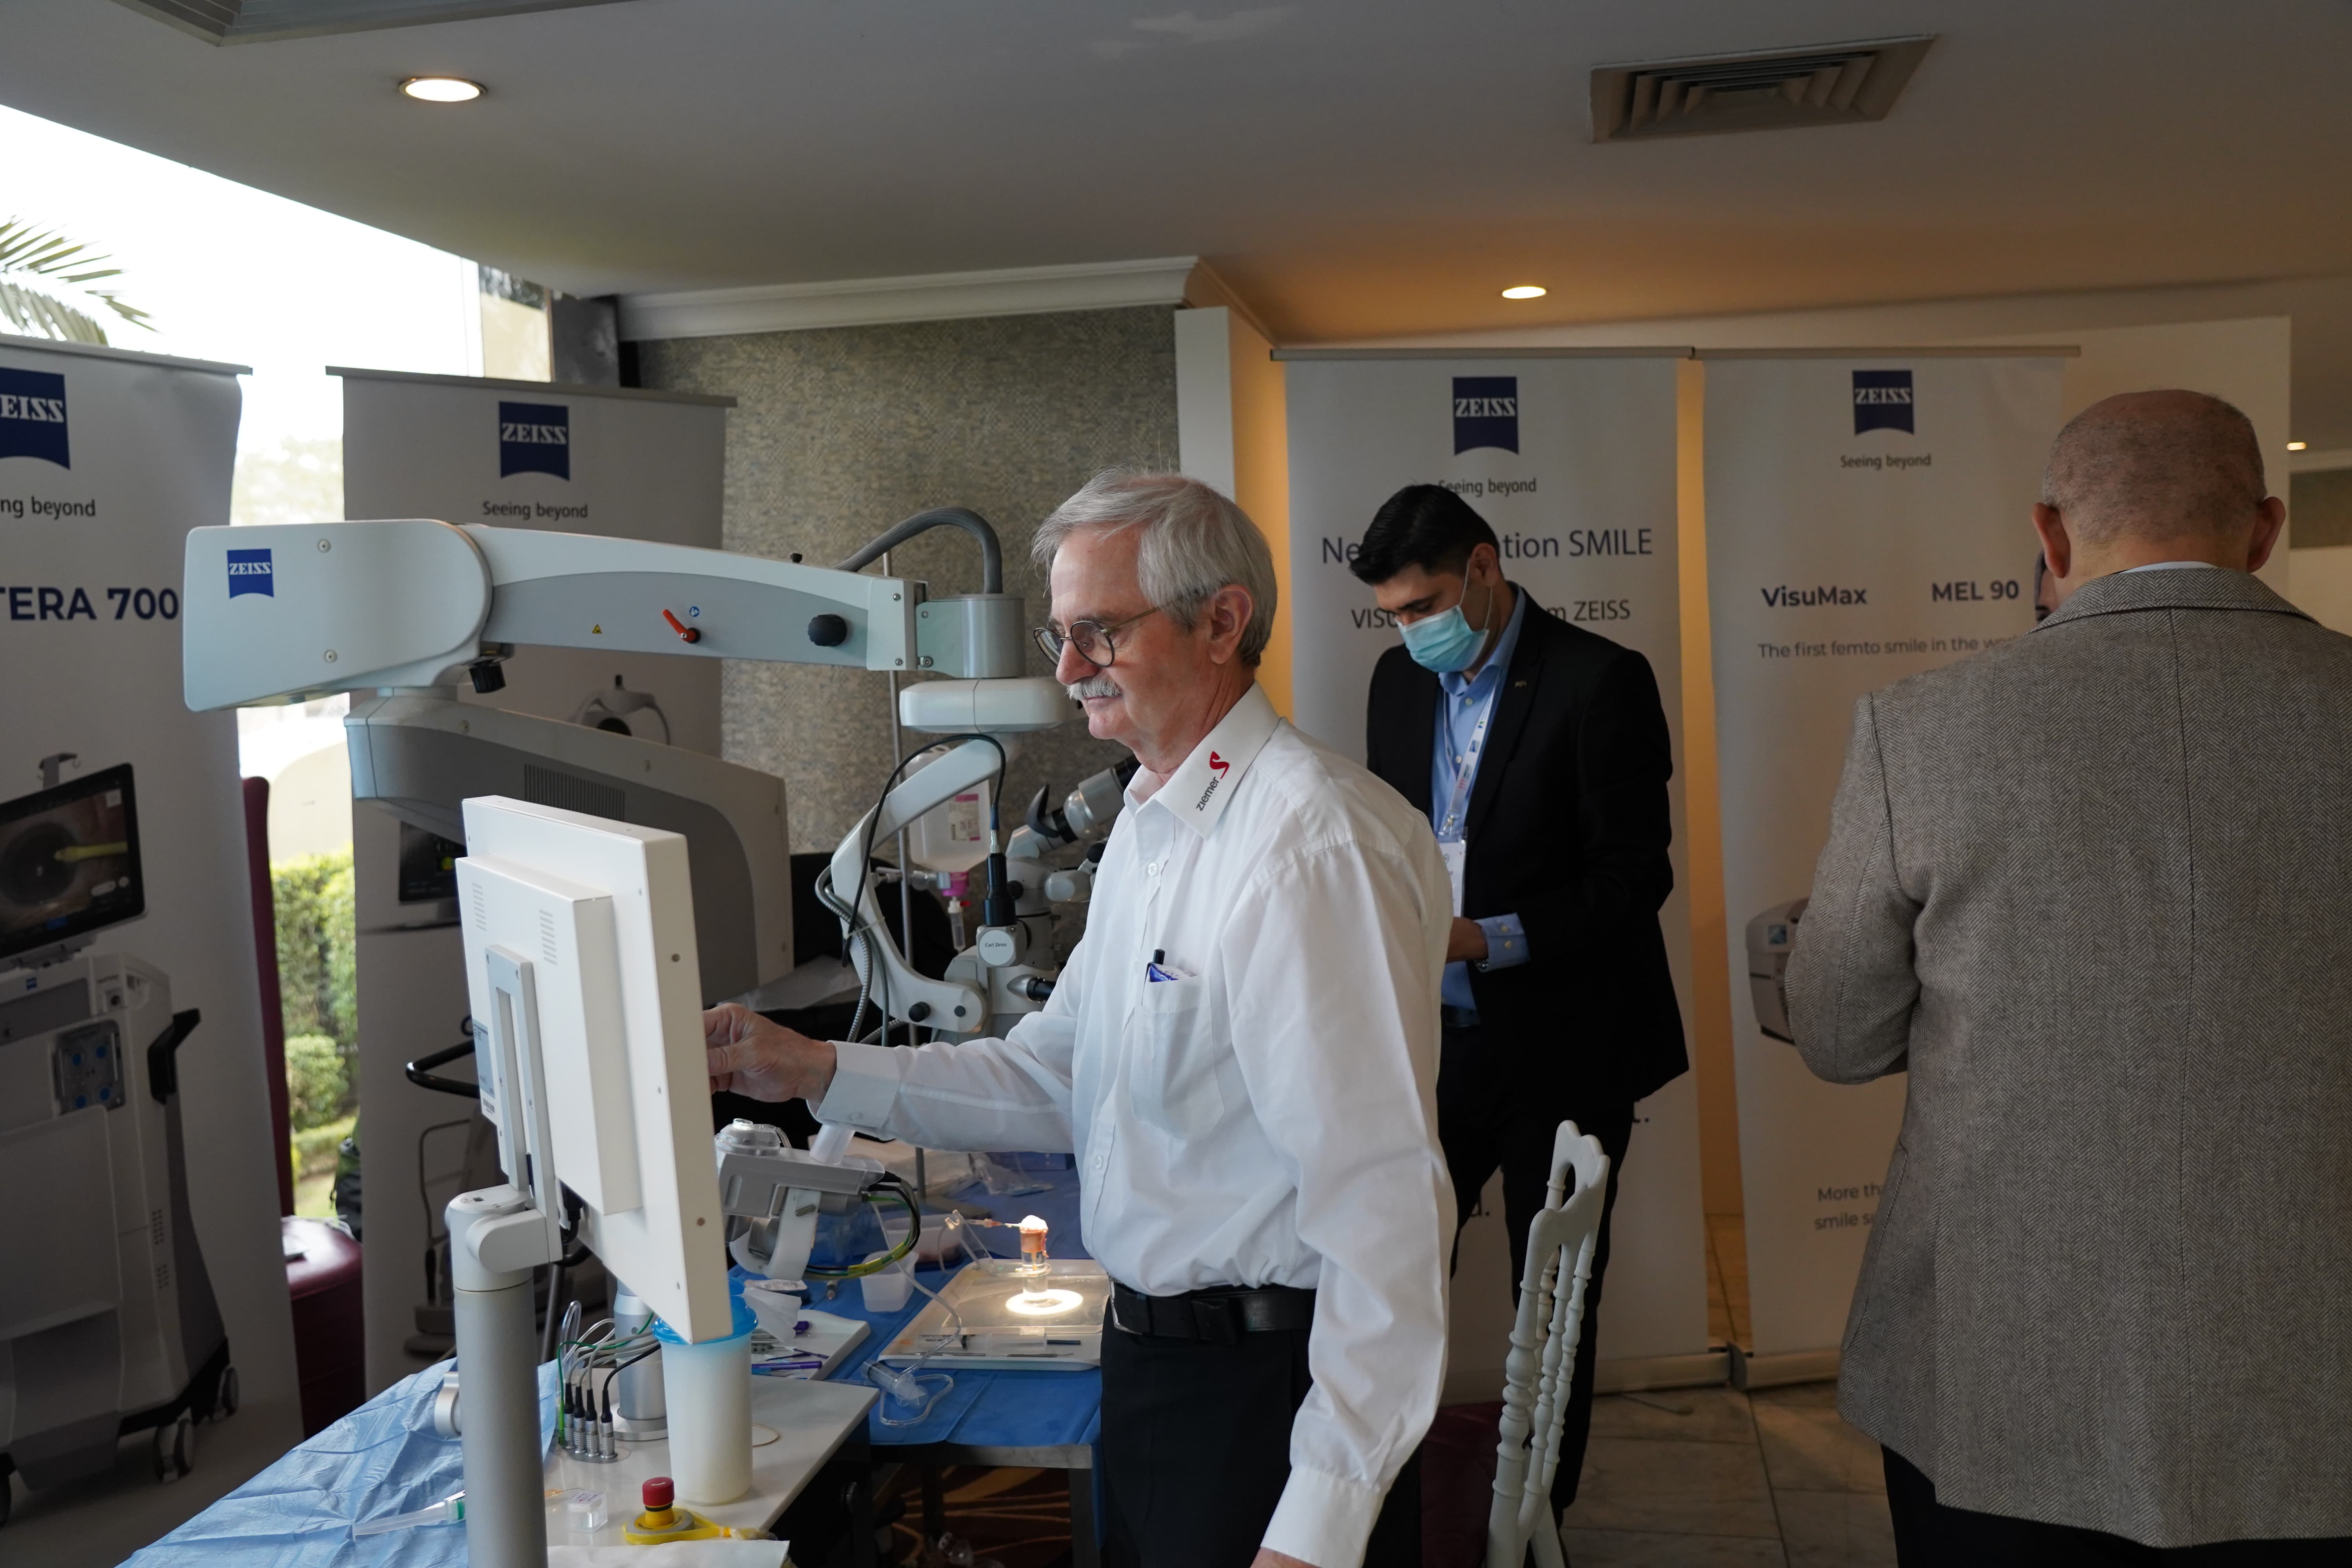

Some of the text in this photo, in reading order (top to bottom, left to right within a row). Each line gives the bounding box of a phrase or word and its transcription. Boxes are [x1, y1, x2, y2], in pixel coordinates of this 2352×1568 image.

[1855, 387, 1912, 405] ZEISS
[0, 394, 64, 423] EISS
[1455, 397, 1516, 417] ZEISS
[501, 423, 568, 445] ZEISS
[1840, 454, 1931, 470] Seeing beyond
[1488, 477, 1537, 497] beyond
[31, 495, 95, 521] beyond
[483, 501, 588, 521] Seeing beyond
[1323, 528, 1652, 564] Ne tion SMILE
[229, 562, 272, 575] ZEISS
[1761, 586, 1867, 607] VisuMax
[1931, 580, 2020, 602] MEL 90
[0, 587, 179, 621] ERA 700
[1573, 599, 1630, 621] ZEISS
[1758, 642, 1790, 658] The
[1795, 641, 1827, 657] first
[1831, 640, 1880, 656] femto
[1884, 638, 1928, 654] smile
[1931, 636, 1946, 651] in
[1951, 636, 1978, 651] the
[1196, 777, 1219, 811] ziemer
[1818, 1187, 1858, 1202] More
[1814, 1212, 1858, 1230] smile
